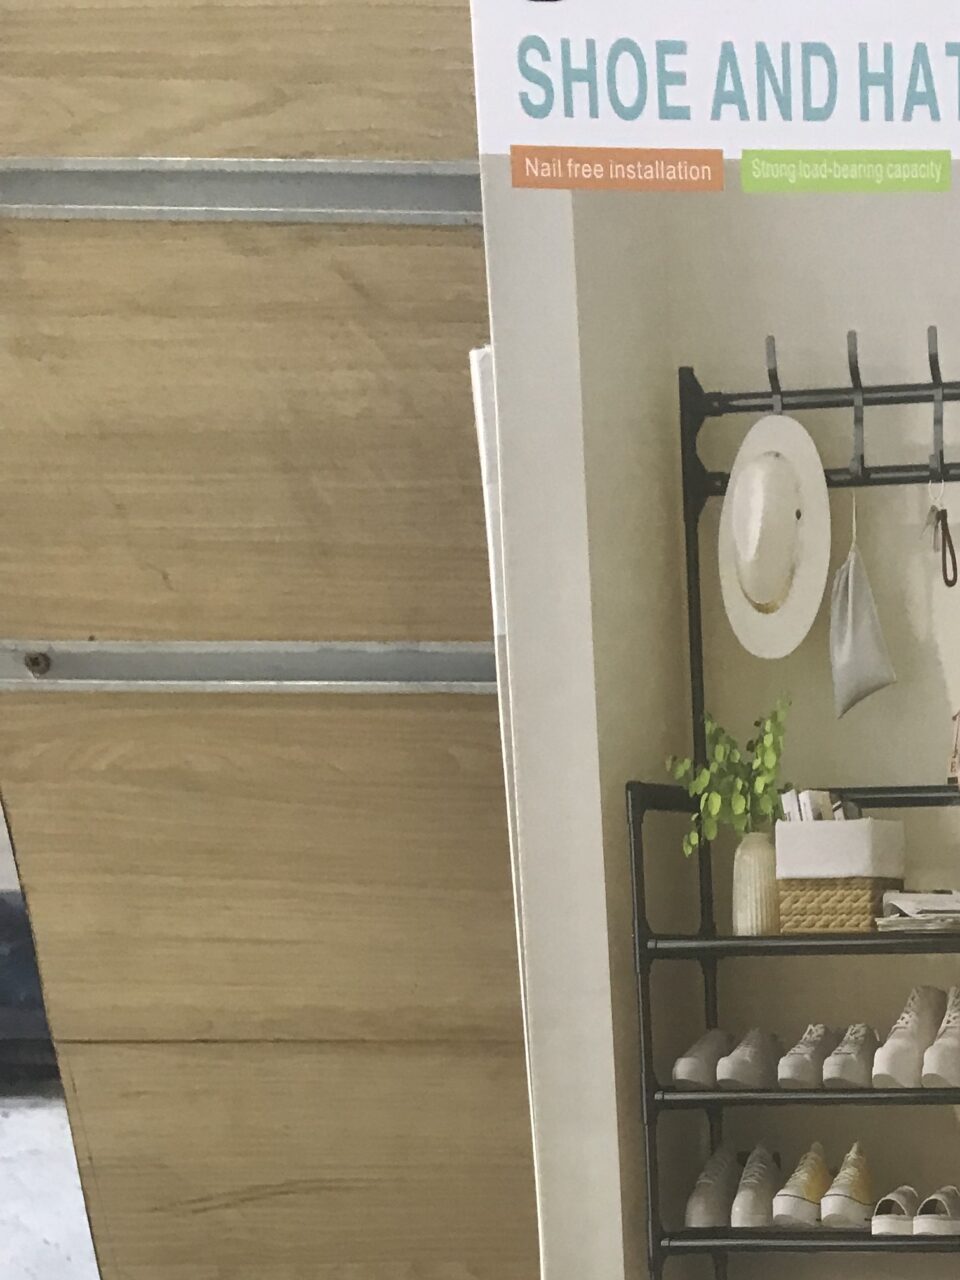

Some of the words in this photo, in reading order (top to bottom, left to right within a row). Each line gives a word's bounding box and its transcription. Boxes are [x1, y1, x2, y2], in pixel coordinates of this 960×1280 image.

[517, 34, 692, 120] SHOE
[710, 40, 838, 122] AND
[525, 158, 562, 178] Nail
[567, 159, 604, 178] free
[609, 160, 711, 181] installation
[751, 158, 797, 183] Strong
[800, 159, 885, 184] load-bearing
[887, 160, 942, 183] capacity
